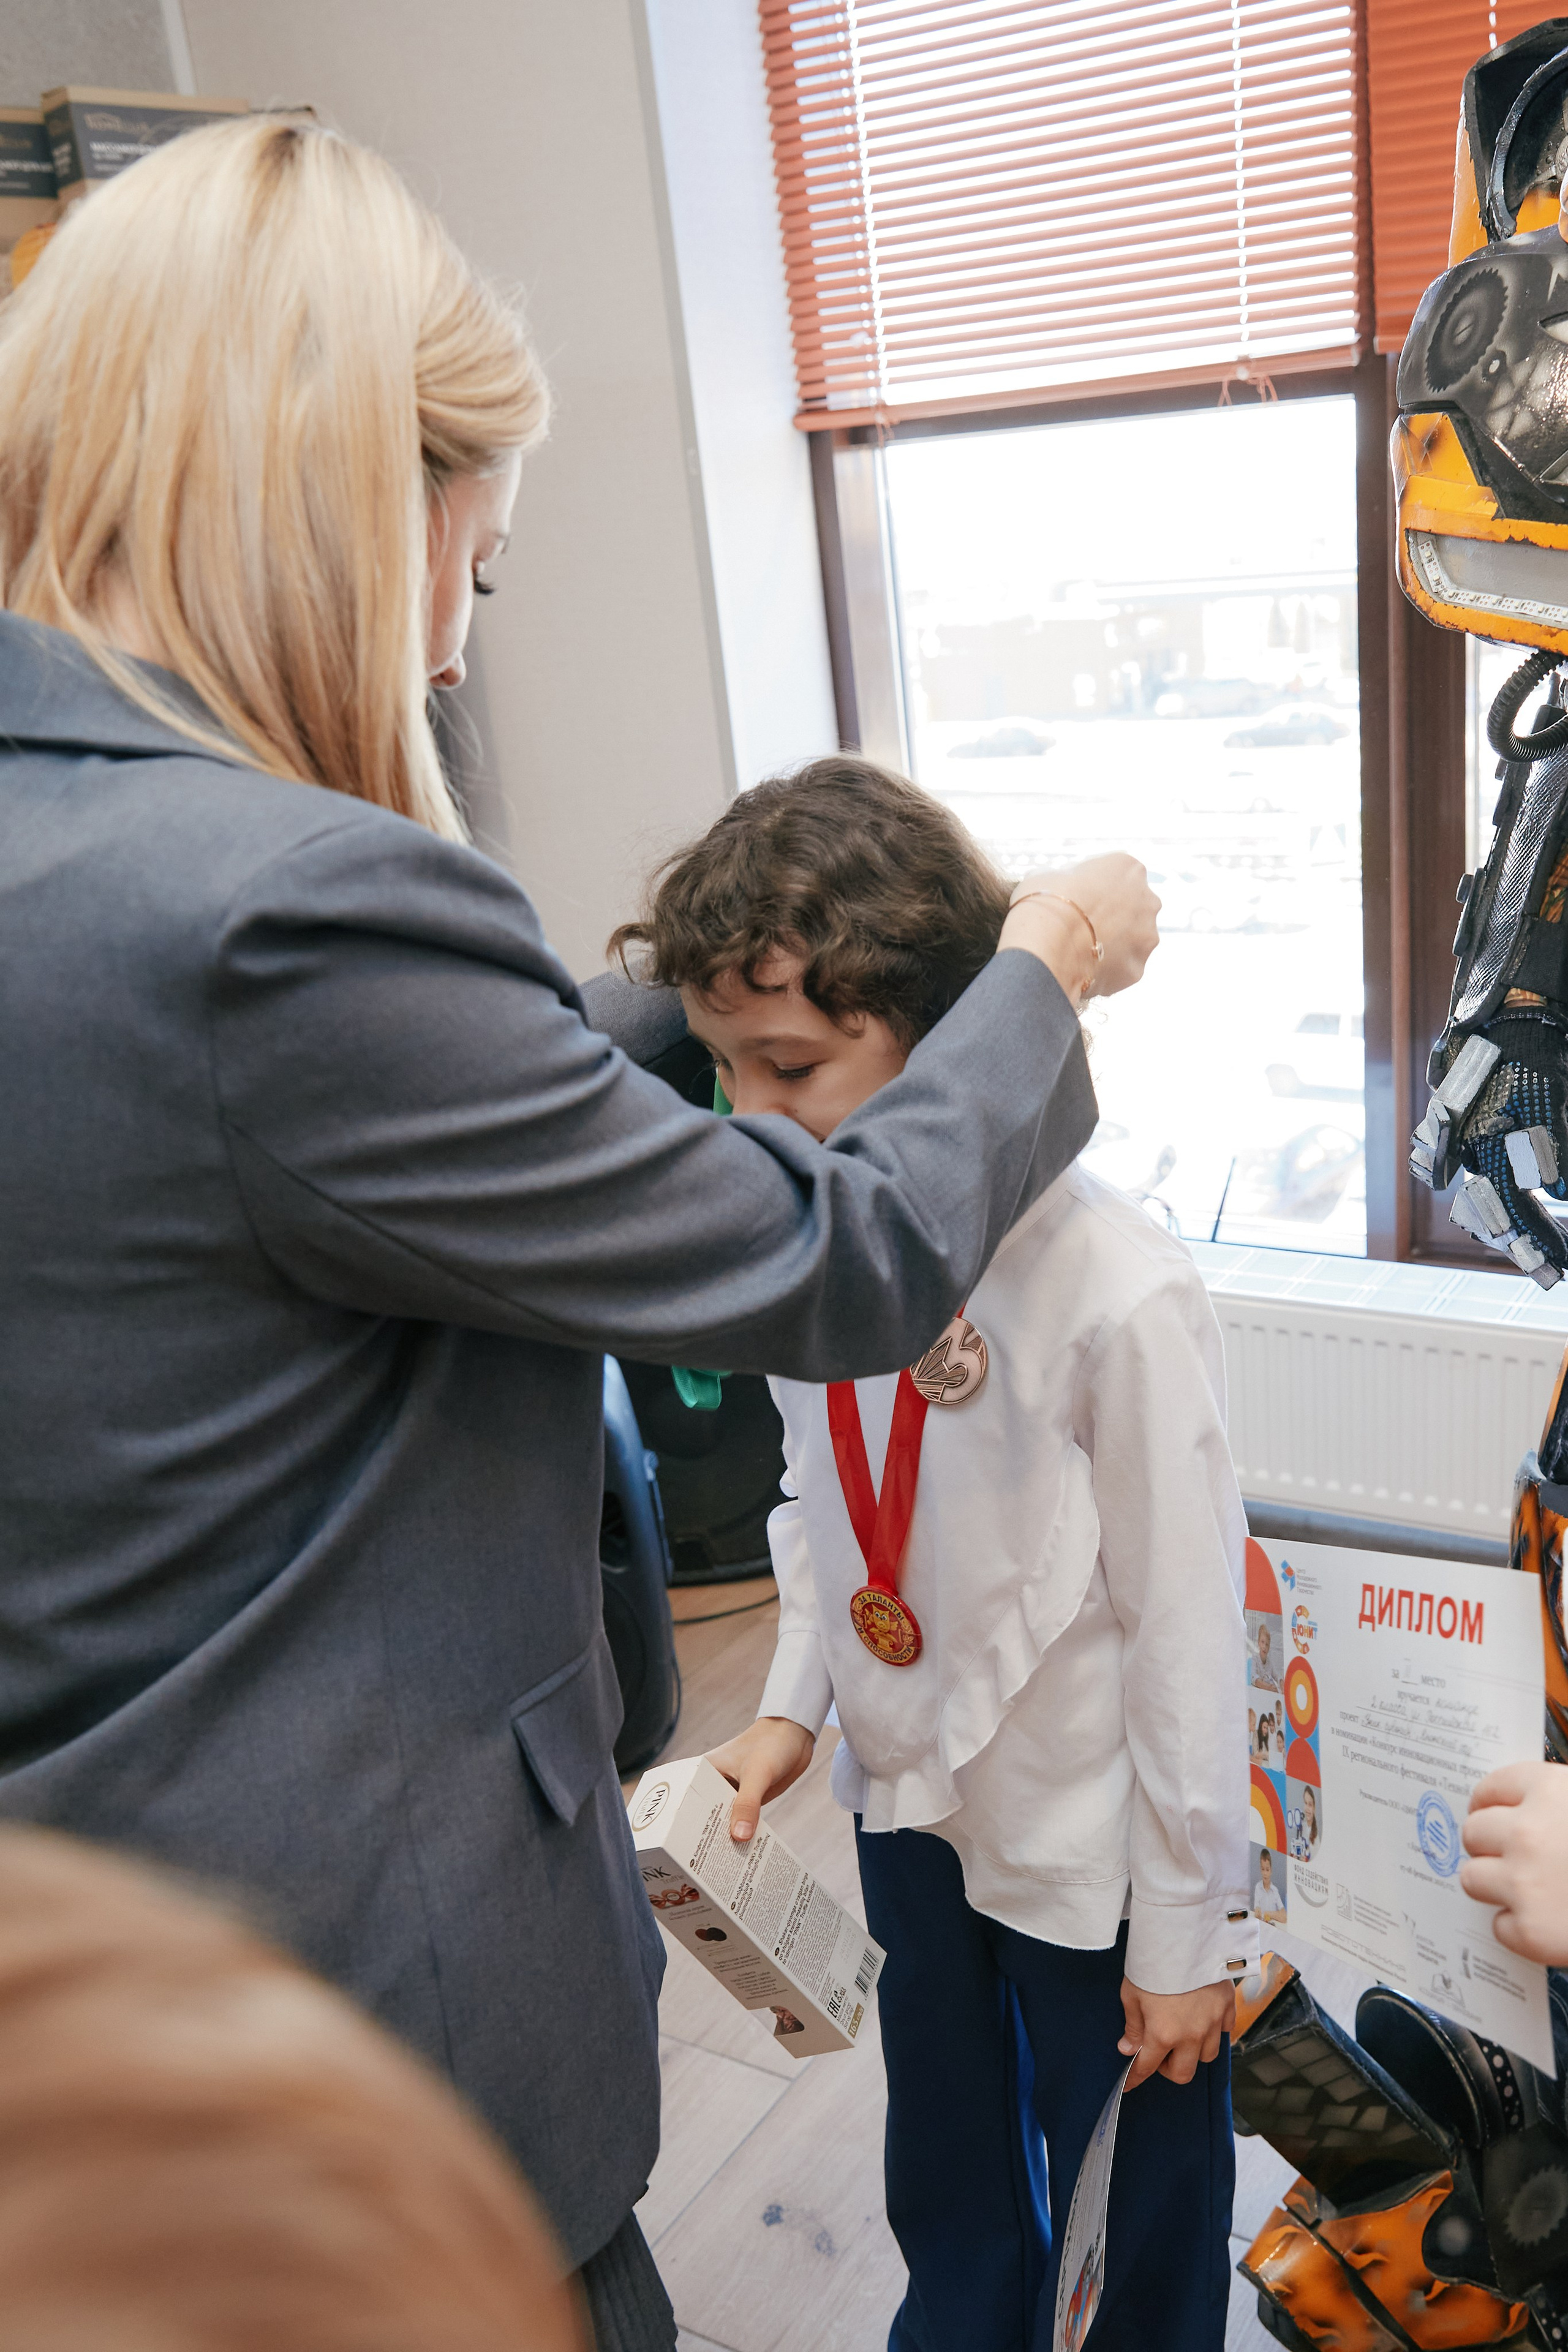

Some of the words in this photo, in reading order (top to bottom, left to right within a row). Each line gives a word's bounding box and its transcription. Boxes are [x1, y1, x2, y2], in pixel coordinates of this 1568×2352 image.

[858, 1596, 867, 1604] ЗА
[867, 1594, 905, 1621] ТАЛАНТЫ
[1359, 1583, 1483, 1645] ДИПЛОМ
[864, 1636, 913, 1661] СПОСОБНОСТИ
[1420, 1673, 1446, 1689] место
[641, 1789, 666, 1823] PINK
[754, 1837, 763, 1851] Truffle
[642, 1866, 671, 1882] INK
[1294, 1872, 1329, 1897] ИННОВАЦИЯМ
[805, 1880, 816, 1903] konfetlari
[778, 1905, 797, 1945] Shakar-qiyomga
[789, 1917, 797, 1934] kremli
[795, 1897, 806, 1918] masalliq
